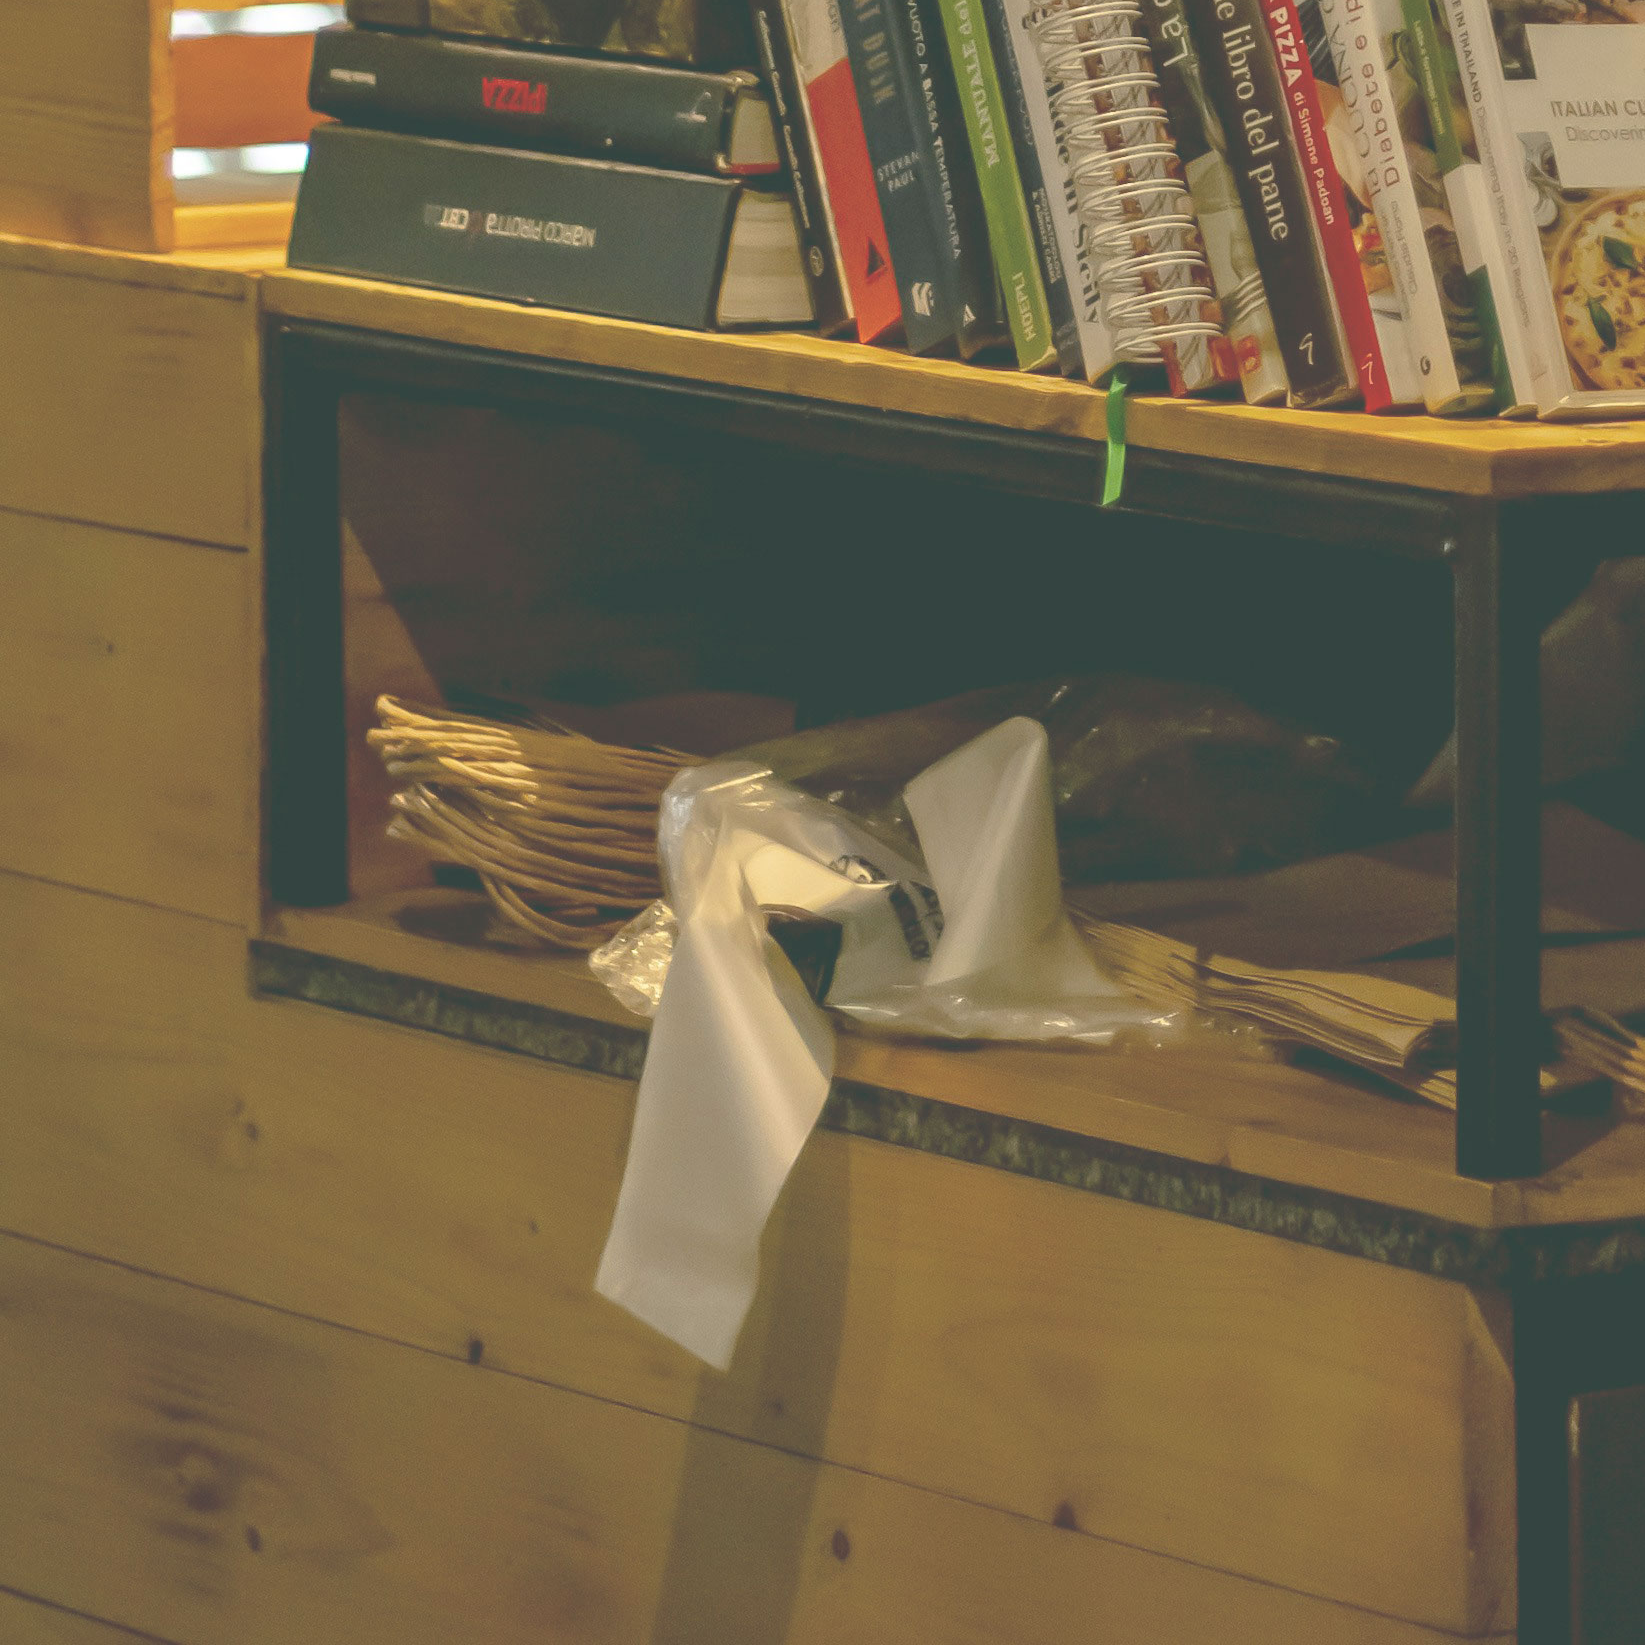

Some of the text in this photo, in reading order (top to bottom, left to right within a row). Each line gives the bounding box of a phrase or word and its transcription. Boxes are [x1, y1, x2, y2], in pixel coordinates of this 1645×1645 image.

[1161, 13, 1191, 68] La
[1269, 5, 1303, 89] PIZZA
[1354, 34, 1368, 51] e
[1454, 11, 1467, 27] IN
[918, 62, 929, 75] A
[1222, 24, 1256, 101] libro
[1326, 23, 1371, 160] CUCINA
[1457, 30, 1482, 104] THAILAND
[922, 77, 940, 133] BASSA
[962, 39, 1000, 169] MANUALE
[1293, 91, 1307, 107] di
[1362, 62, 1400, 188] Diabete
[1550, 100, 1619, 118] ITALIAN
[1242, 108, 1280, 155] del
[1298, 107, 1318, 165] Simone
[877, 150, 919, 183] STEVAN
[887, 169, 917, 193] PAUL
[932, 134, 962, 260] TEMPERATURA
[1248, 161, 1289, 242] pane
[1313, 167, 1335, 226] Padoan
[1010, 270, 1037, 343] HOEPLI
